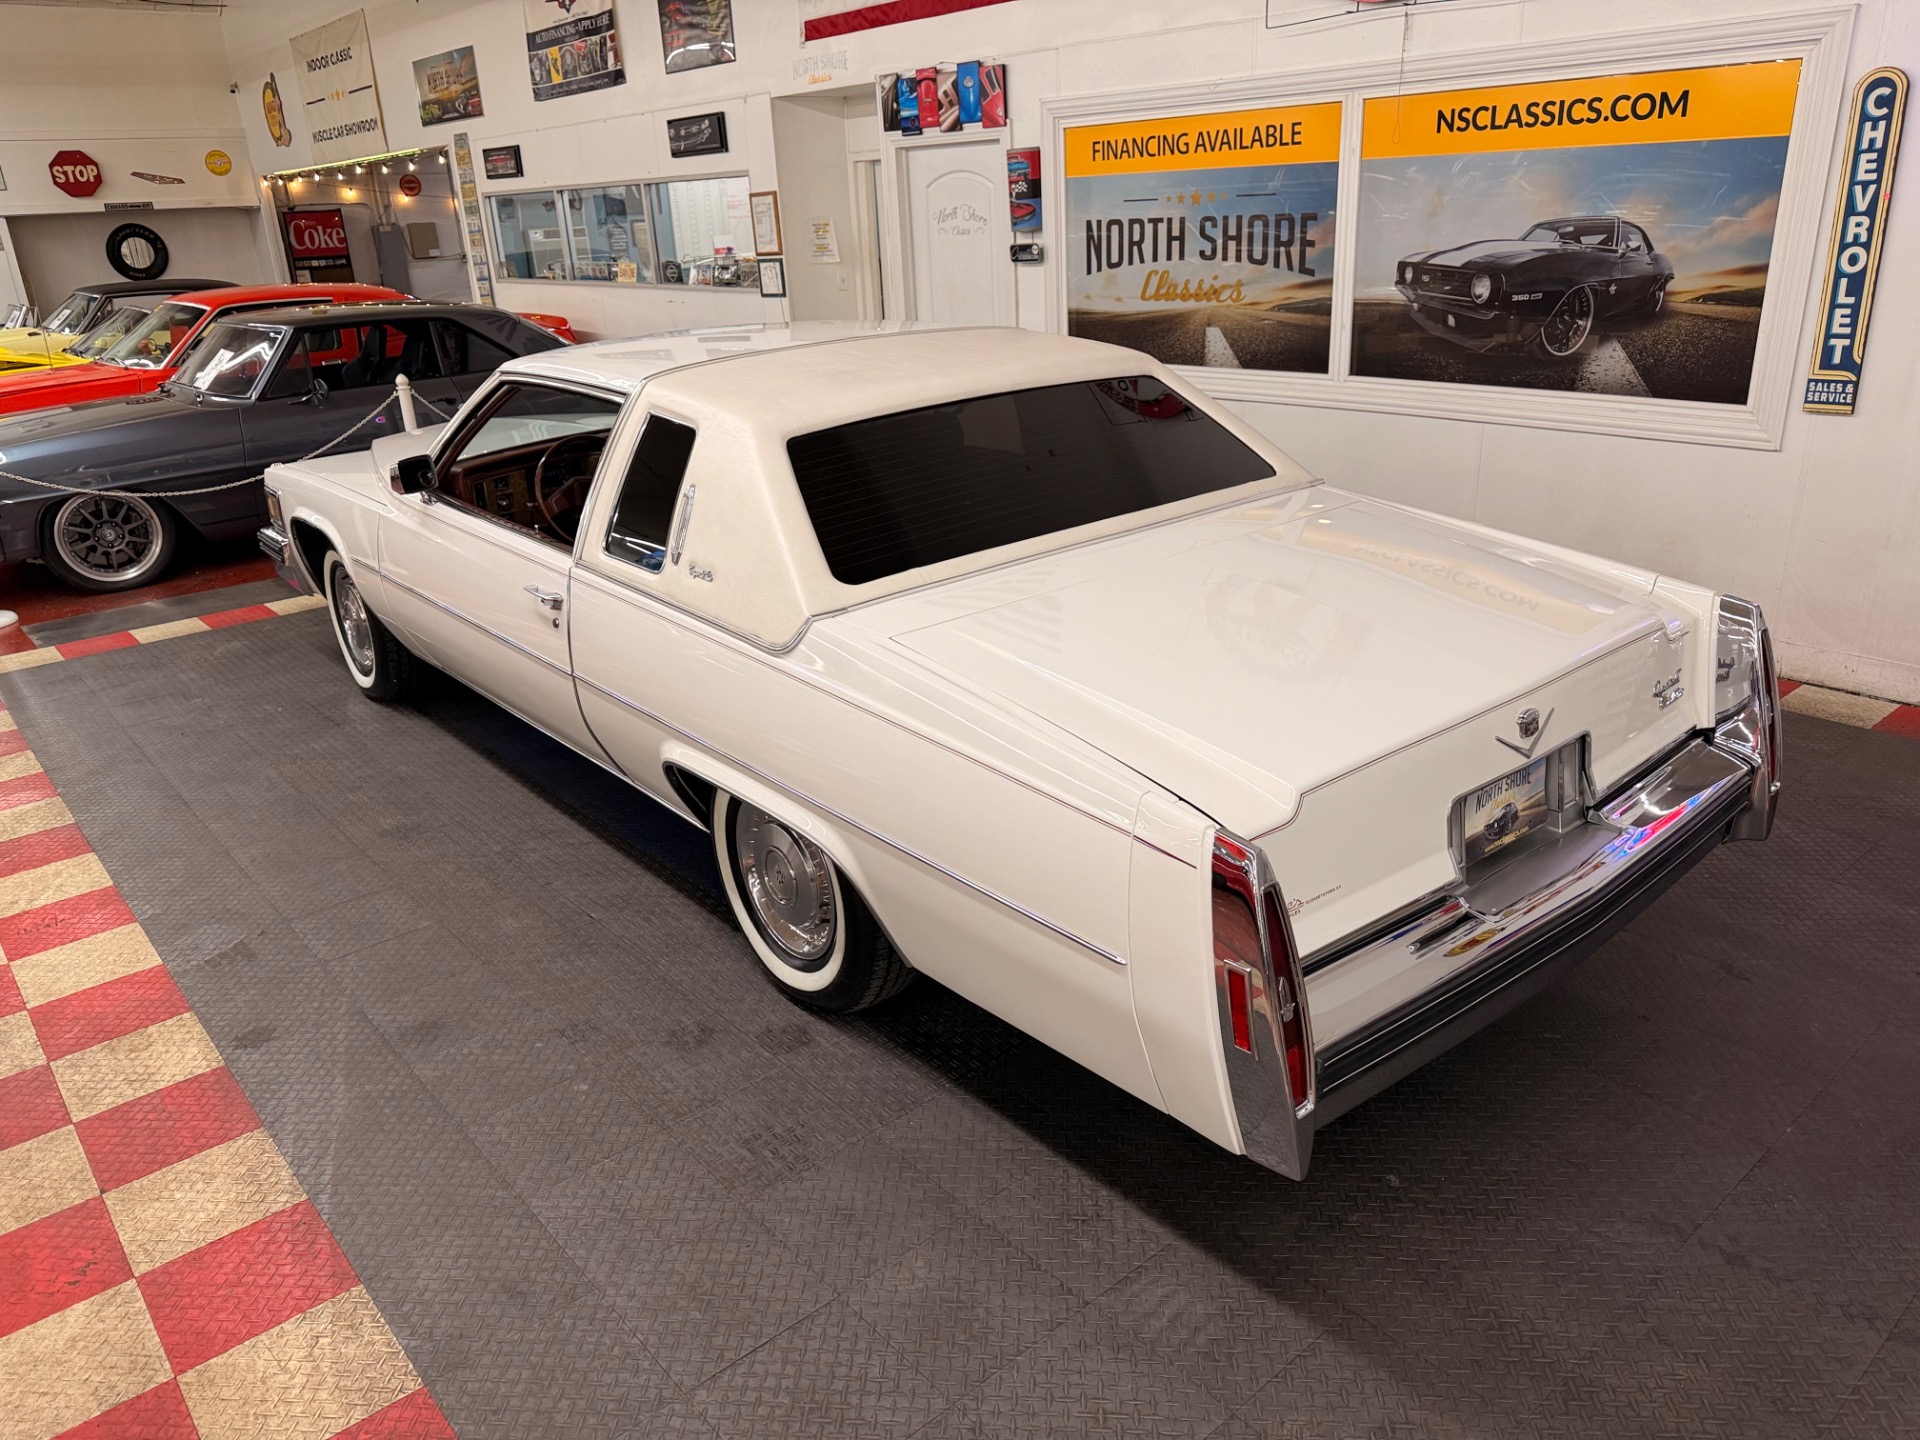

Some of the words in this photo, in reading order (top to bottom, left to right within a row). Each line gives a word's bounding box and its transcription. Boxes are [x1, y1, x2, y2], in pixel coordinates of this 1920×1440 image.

[305, 54, 330, 73] INDOOR
[330, 46, 353, 66] CLASSIC
[792, 56, 819, 81] NORTH
[820, 49, 849, 71] SHORE
[1436, 89, 1690, 134] NSCLASSICS.COM
[312, 128, 334, 144] MUSCLE
[334, 124, 345, 138] CAR
[344, 117, 379, 137] SHOWROOM
[1092, 132, 1190, 162] FINANCING
[1194, 121, 1303, 154] AVAILABLE
[52, 164, 98, 184] STOP
[933, 205, 959, 226] North
[960, 203, 988, 226] Shore
[1826, 86, 1893, 365] CHEVROLET
[289, 220, 347, 250] Coke
[1086, 216, 1186, 276] NORTH
[1199, 212, 1319, 278] SHORE
[1140, 269, 1247, 304] Classics
[1806, 391, 1853, 404] SERVICE
[1809, 381, 1843, 393] SALES
[1845, 383, 1854, 393] &
[1475, 779, 1504, 814] NORTH
[1505, 767, 1532, 792] SHORE
